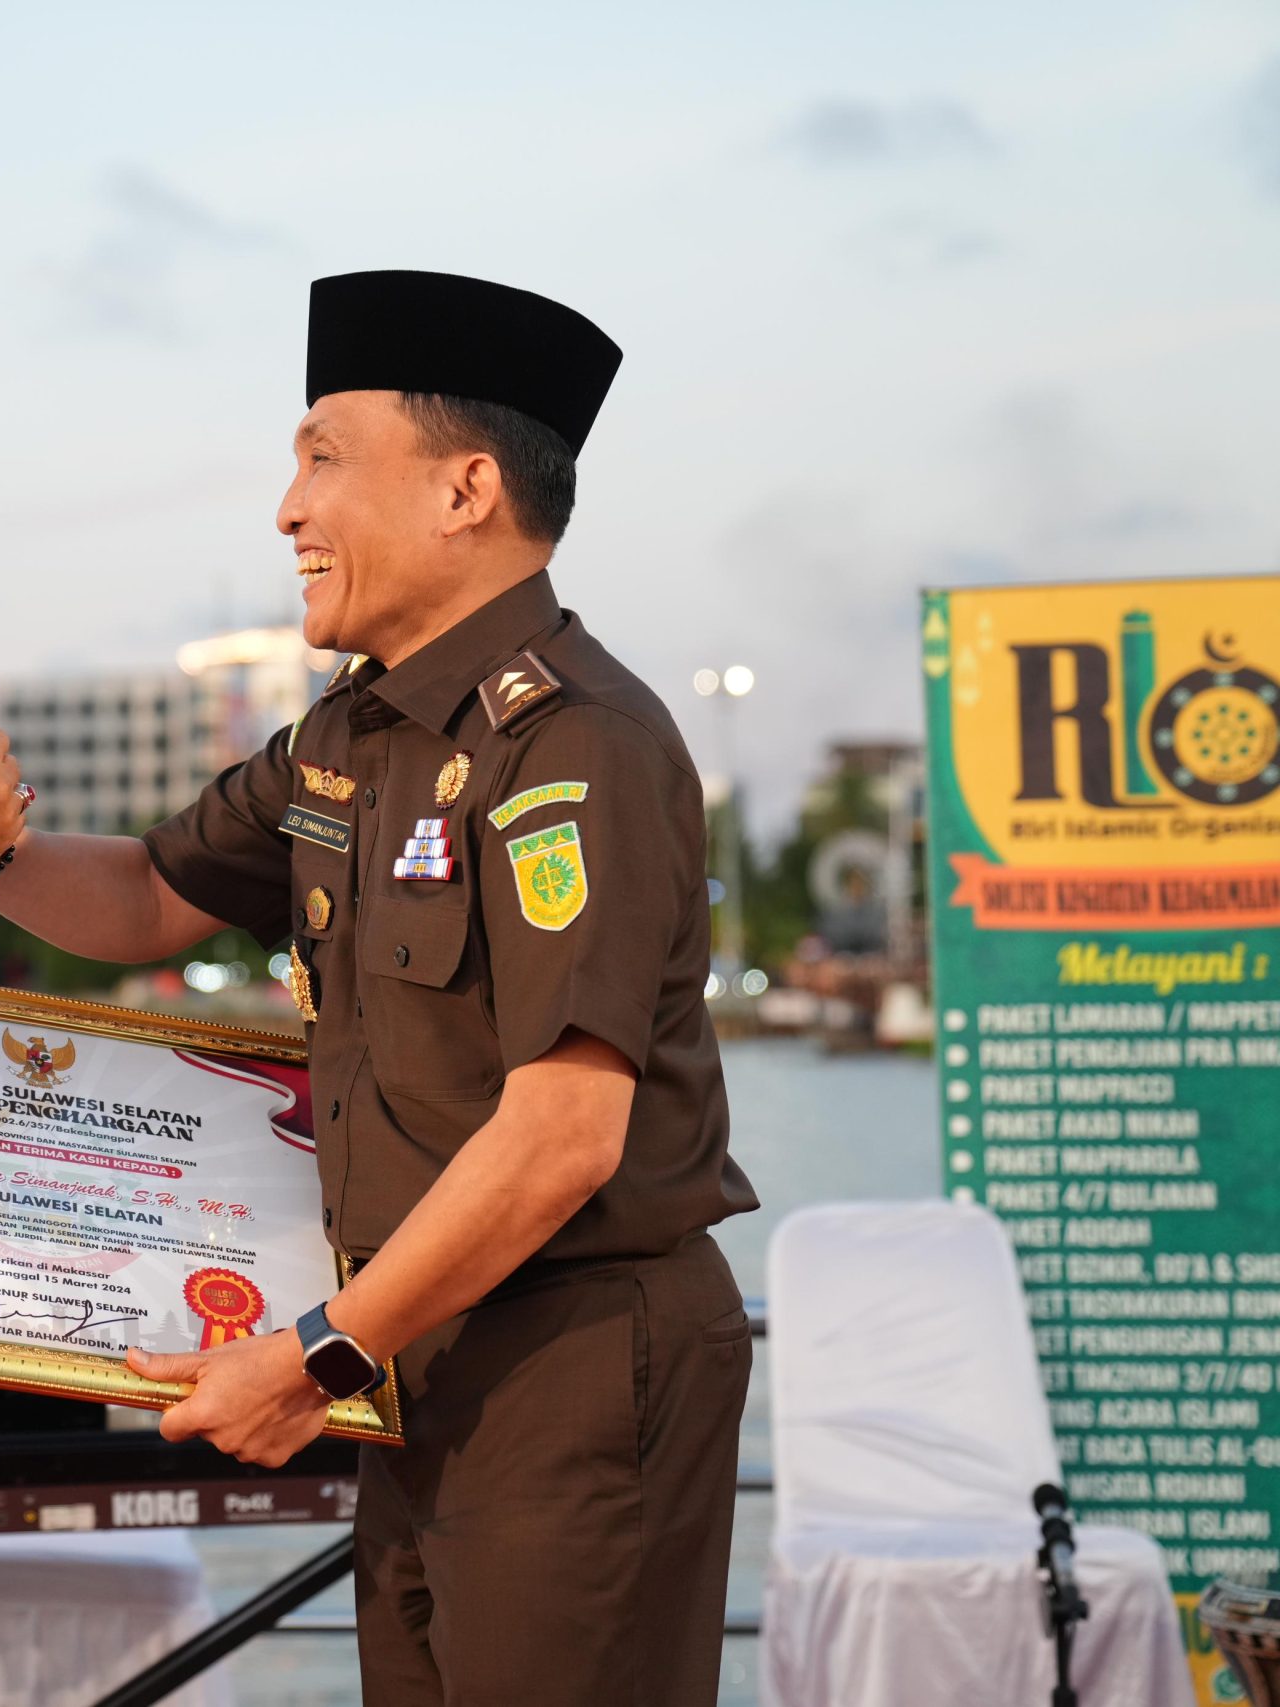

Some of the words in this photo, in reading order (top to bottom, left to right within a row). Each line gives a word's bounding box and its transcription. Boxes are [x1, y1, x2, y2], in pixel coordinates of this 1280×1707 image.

[495, 787, 563, 825] KEJAKSAAN
[569, 787, 582, 800] RI
[287, 814, 301, 827] LEO
[301, 819, 348, 842] SIMANJUNTAK
[1058, 942, 1246, 995] Melayani
[978, 1003, 1051, 1033] PAKET
[980, 1039, 1052, 1068] PAKET
[1186, 1037, 1233, 1066] PRA
[982, 1074, 1054, 1103] PAKET
[2, 1085, 104, 1111] SULAWESI
[112, 1103, 201, 1127] SELATAN
[984, 1110, 1056, 1139] PAKET
[14, 1144, 65, 1159] TERIMA
[70, 1153, 109, 1166] KASIH
[113, 1160, 168, 1175] KEPADA
[36, 1136, 54, 1144] DAN
[58, 1140, 113, 1154] MASYARAKAT
[116, 1149, 157, 1161] SULAWESI
[160, 1156, 196, 1167] SELATAN
[986, 1146, 1057, 1175] PAKET
[987, 1181, 1059, 1211] PAKET
[1109, 1181, 1216, 1210] BULANAN
[84, 1204, 162, 1225] SELATAN
[22, 1224, 53, 1234] PEMILU
[57, 1229, 100, 1241] SERENTAK
[103, 1236, 133, 1246] TAHUN
[136, 1241, 157, 1250] 2024
[172, 1247, 214, 1259] SULAWESI
[217, 1254, 253, 1265] SELATAN
[32, 1217, 77, 1229] ANGGOTA
[80, 1224, 138, 1239] FORKOPIMDA
[141, 1234, 183, 1245] SULAWESI
[186, 1241, 222, 1251] SELATAN
[226, 1247, 256, 1257] DALAM
[49, 1237, 76, 1246] AMAN
[80, 1241, 98, 1249] DAN
[101, 1245, 133, 1255] DAMAI.
[1003, 1218, 1060, 1247] AKET
[36, 1262, 47, 1270] di
[52, 1264, 109, 1280] Makassar
[45, 1275, 58, 1284] 15
[62, 1278, 97, 1290] Maret
[102, 1284, 130, 1295] 2024
[96, 1303, 147, 1317] SELATAN
[111, 1489, 199, 1525] KORG
